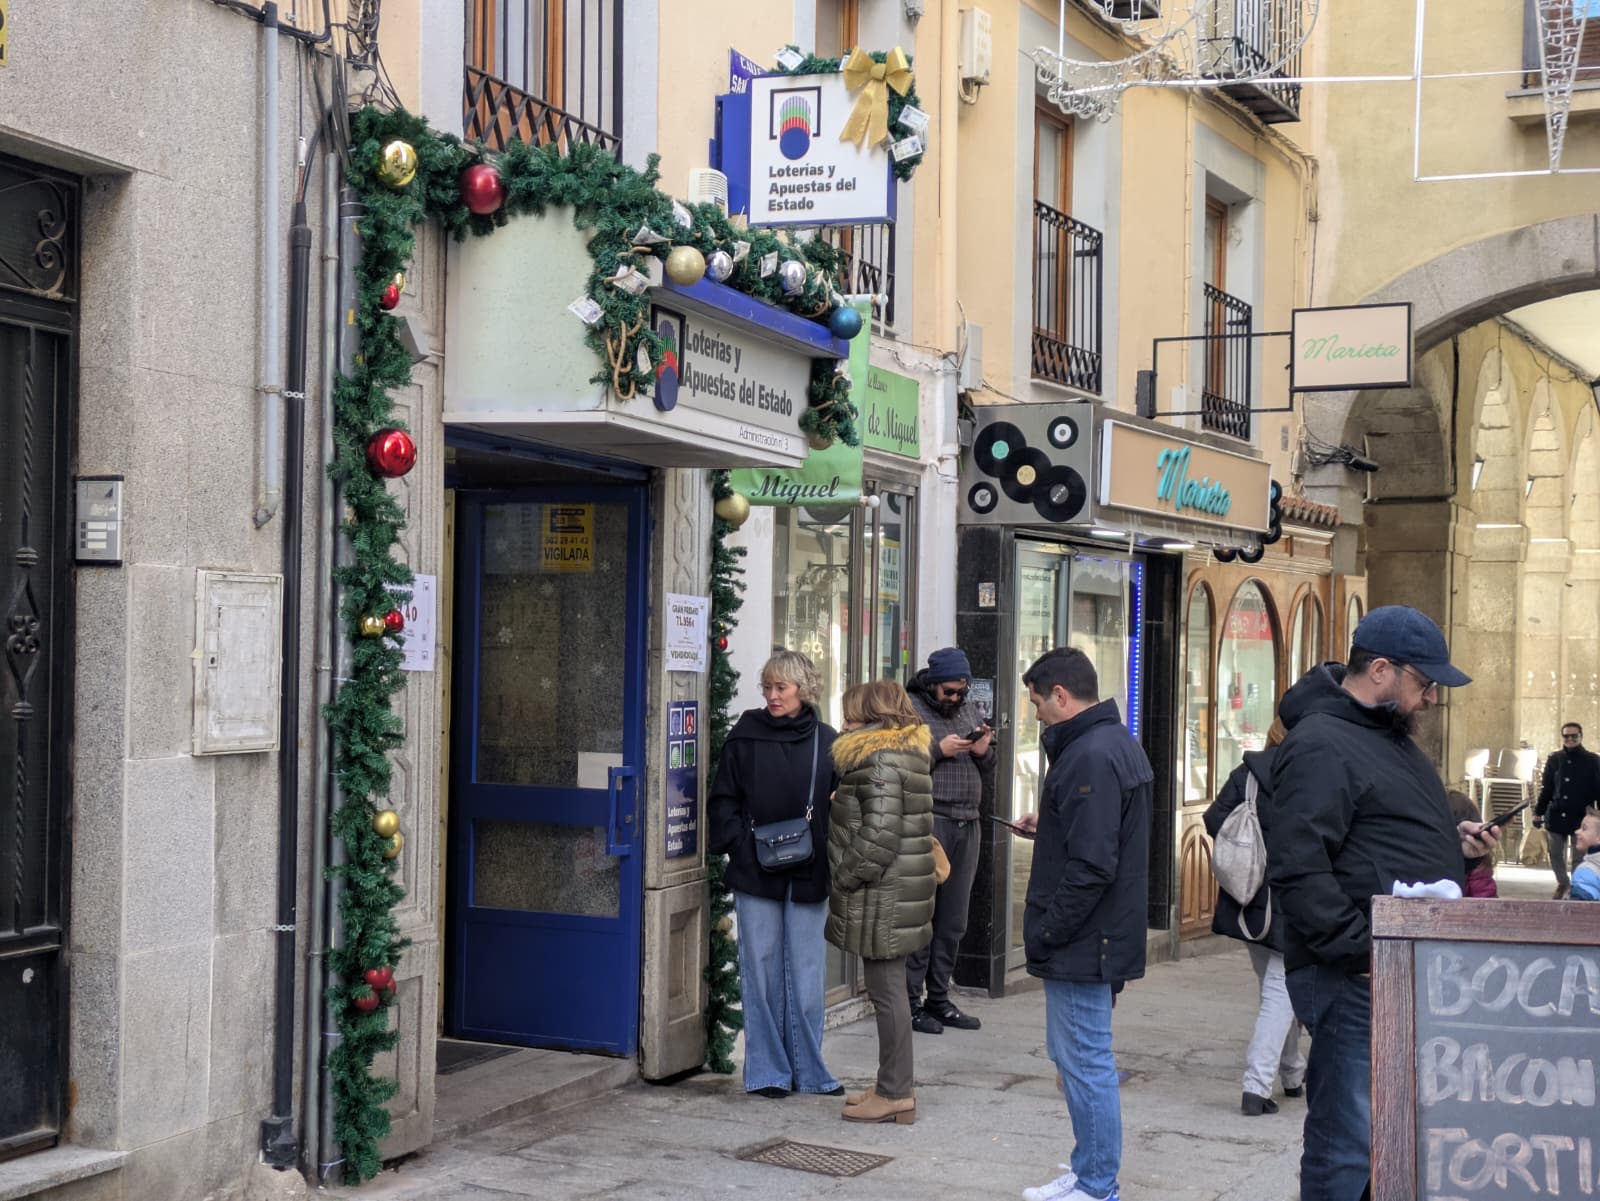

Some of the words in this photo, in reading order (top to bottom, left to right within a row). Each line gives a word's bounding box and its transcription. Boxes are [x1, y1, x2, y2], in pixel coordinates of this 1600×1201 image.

[769, 163, 824, 178] Loterías
[828, 165, 836, 178] y
[769, 181, 832, 197] Apuestas
[836, 177, 856, 192] del
[768, 198, 815, 212] Estado
[685, 323, 732, 364] Loterías
[734, 345, 742, 373] y
[1302, 334, 1401, 361] Marieta
[684, 362, 736, 401] Apuestas
[739, 378, 756, 407] del
[758, 384, 793, 417] Estado
[868, 402, 880, 436] de
[883, 407, 918, 449] Miguel
[751, 474, 841, 505] Miguel
[1157, 445, 1232, 516] Marieta
[544, 547, 589, 561] VIGILADA
[668, 821, 688, 837] Apuestas
[1421, 1036, 1596, 1107] BACON
[1424, 1127, 1600, 1196] TORTI
